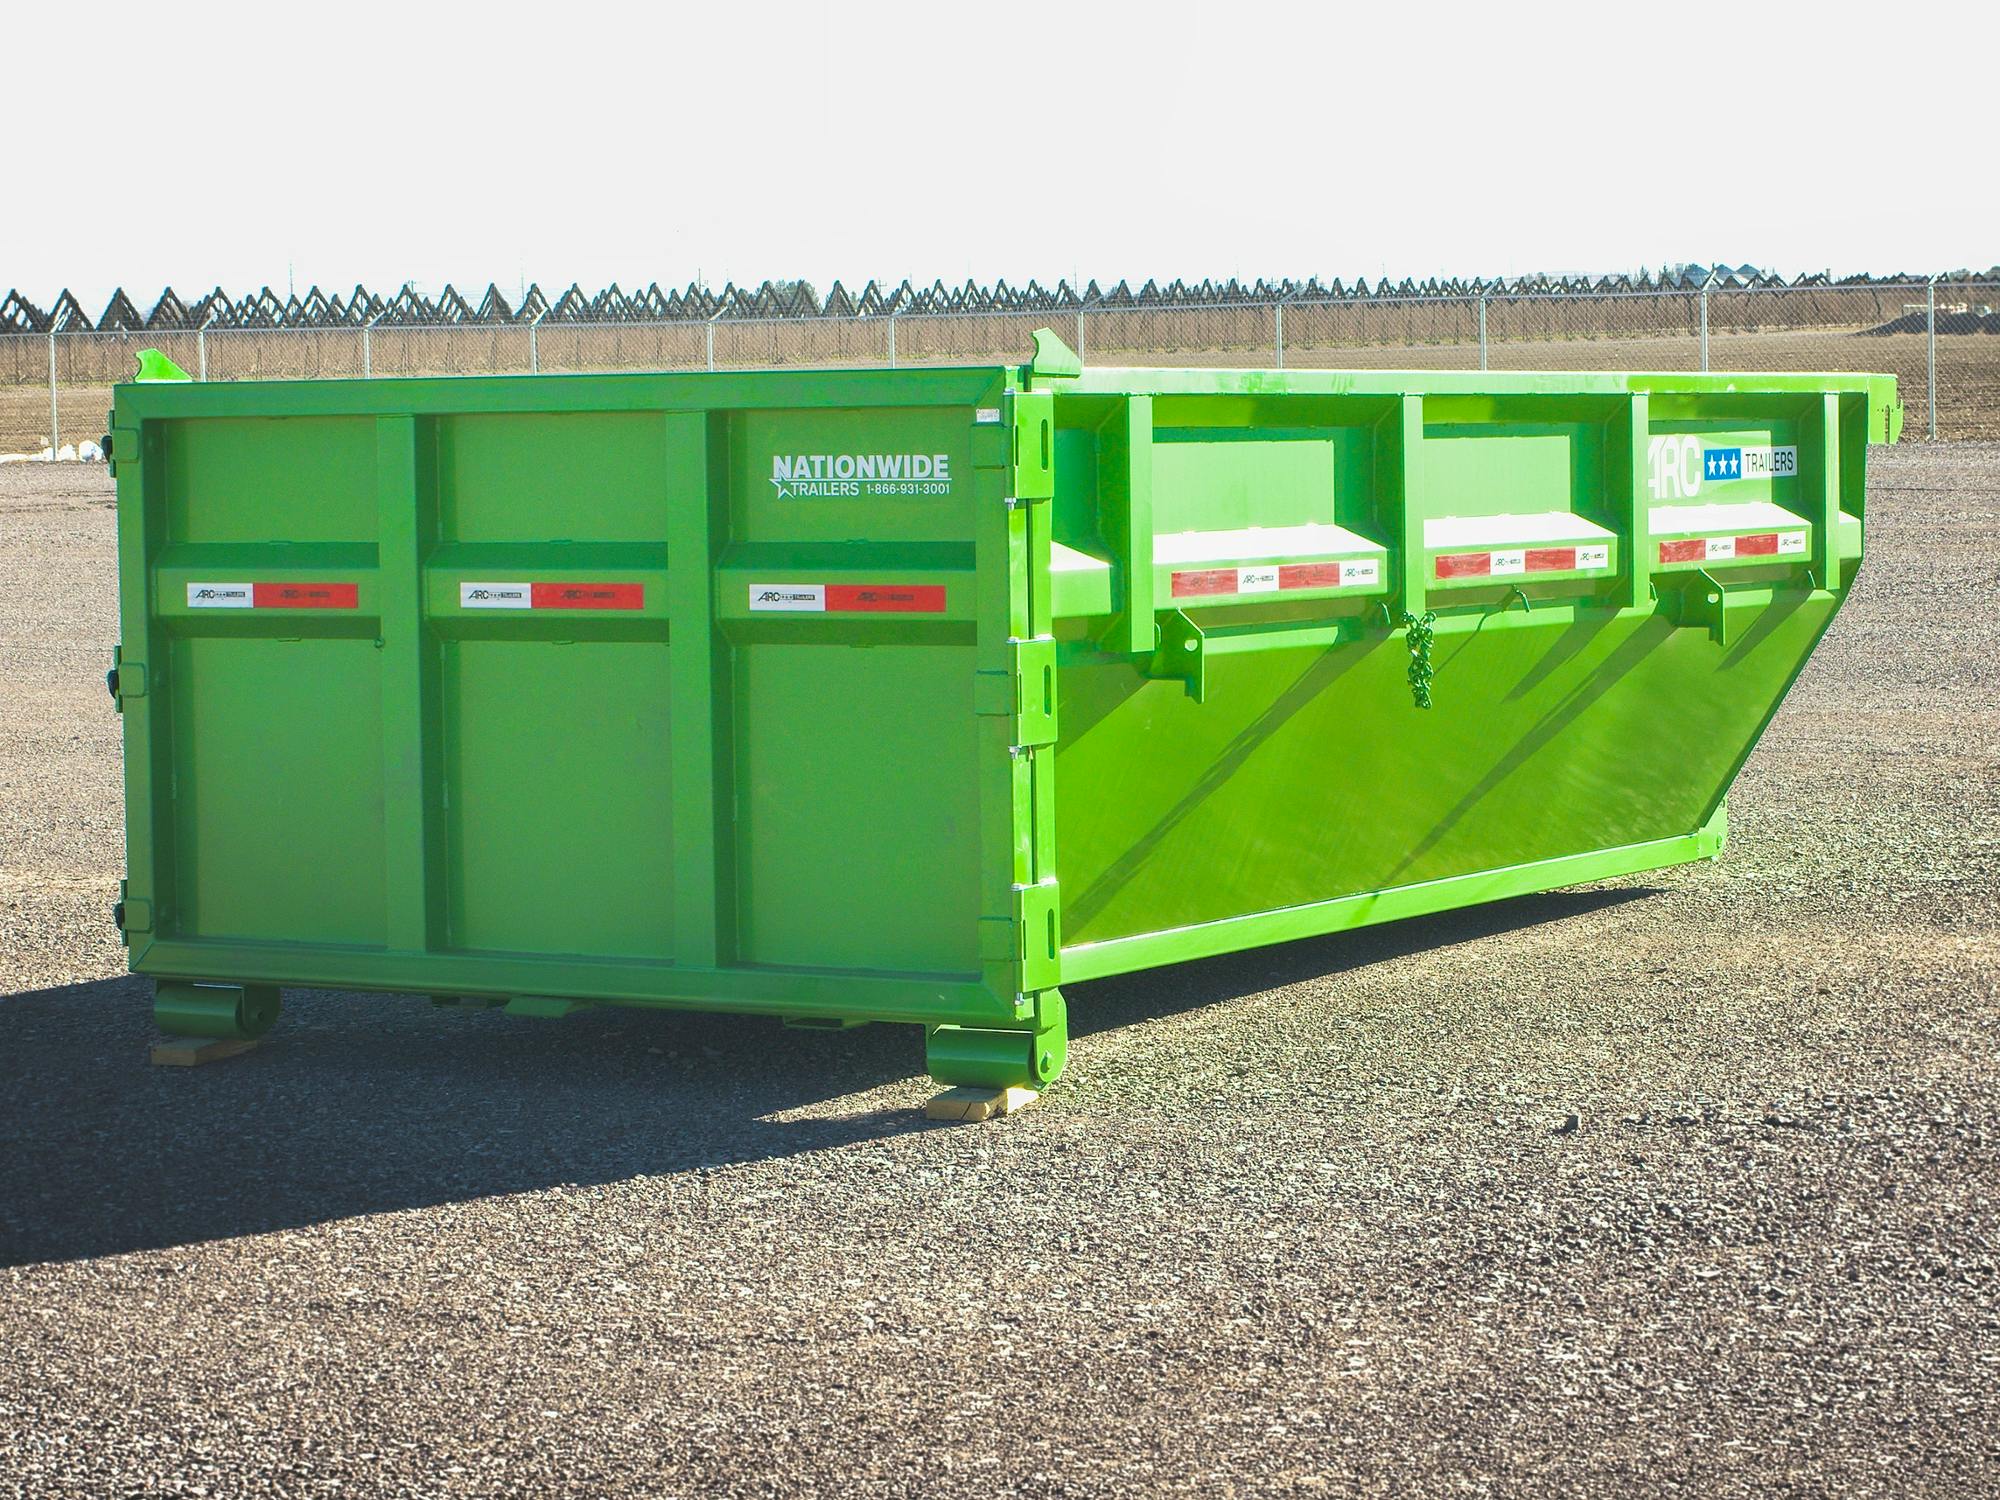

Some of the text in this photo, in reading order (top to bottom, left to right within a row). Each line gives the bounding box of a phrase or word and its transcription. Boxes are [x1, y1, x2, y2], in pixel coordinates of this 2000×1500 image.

[773, 454, 949, 479] NATIONWIDE
[1745, 451, 1794, 473] TRAILERS
[790, 482, 950, 496] TRAILERS 1-866-931-3001
[468, 589, 489, 600] ARC
[757, 591, 780, 602] ARC
